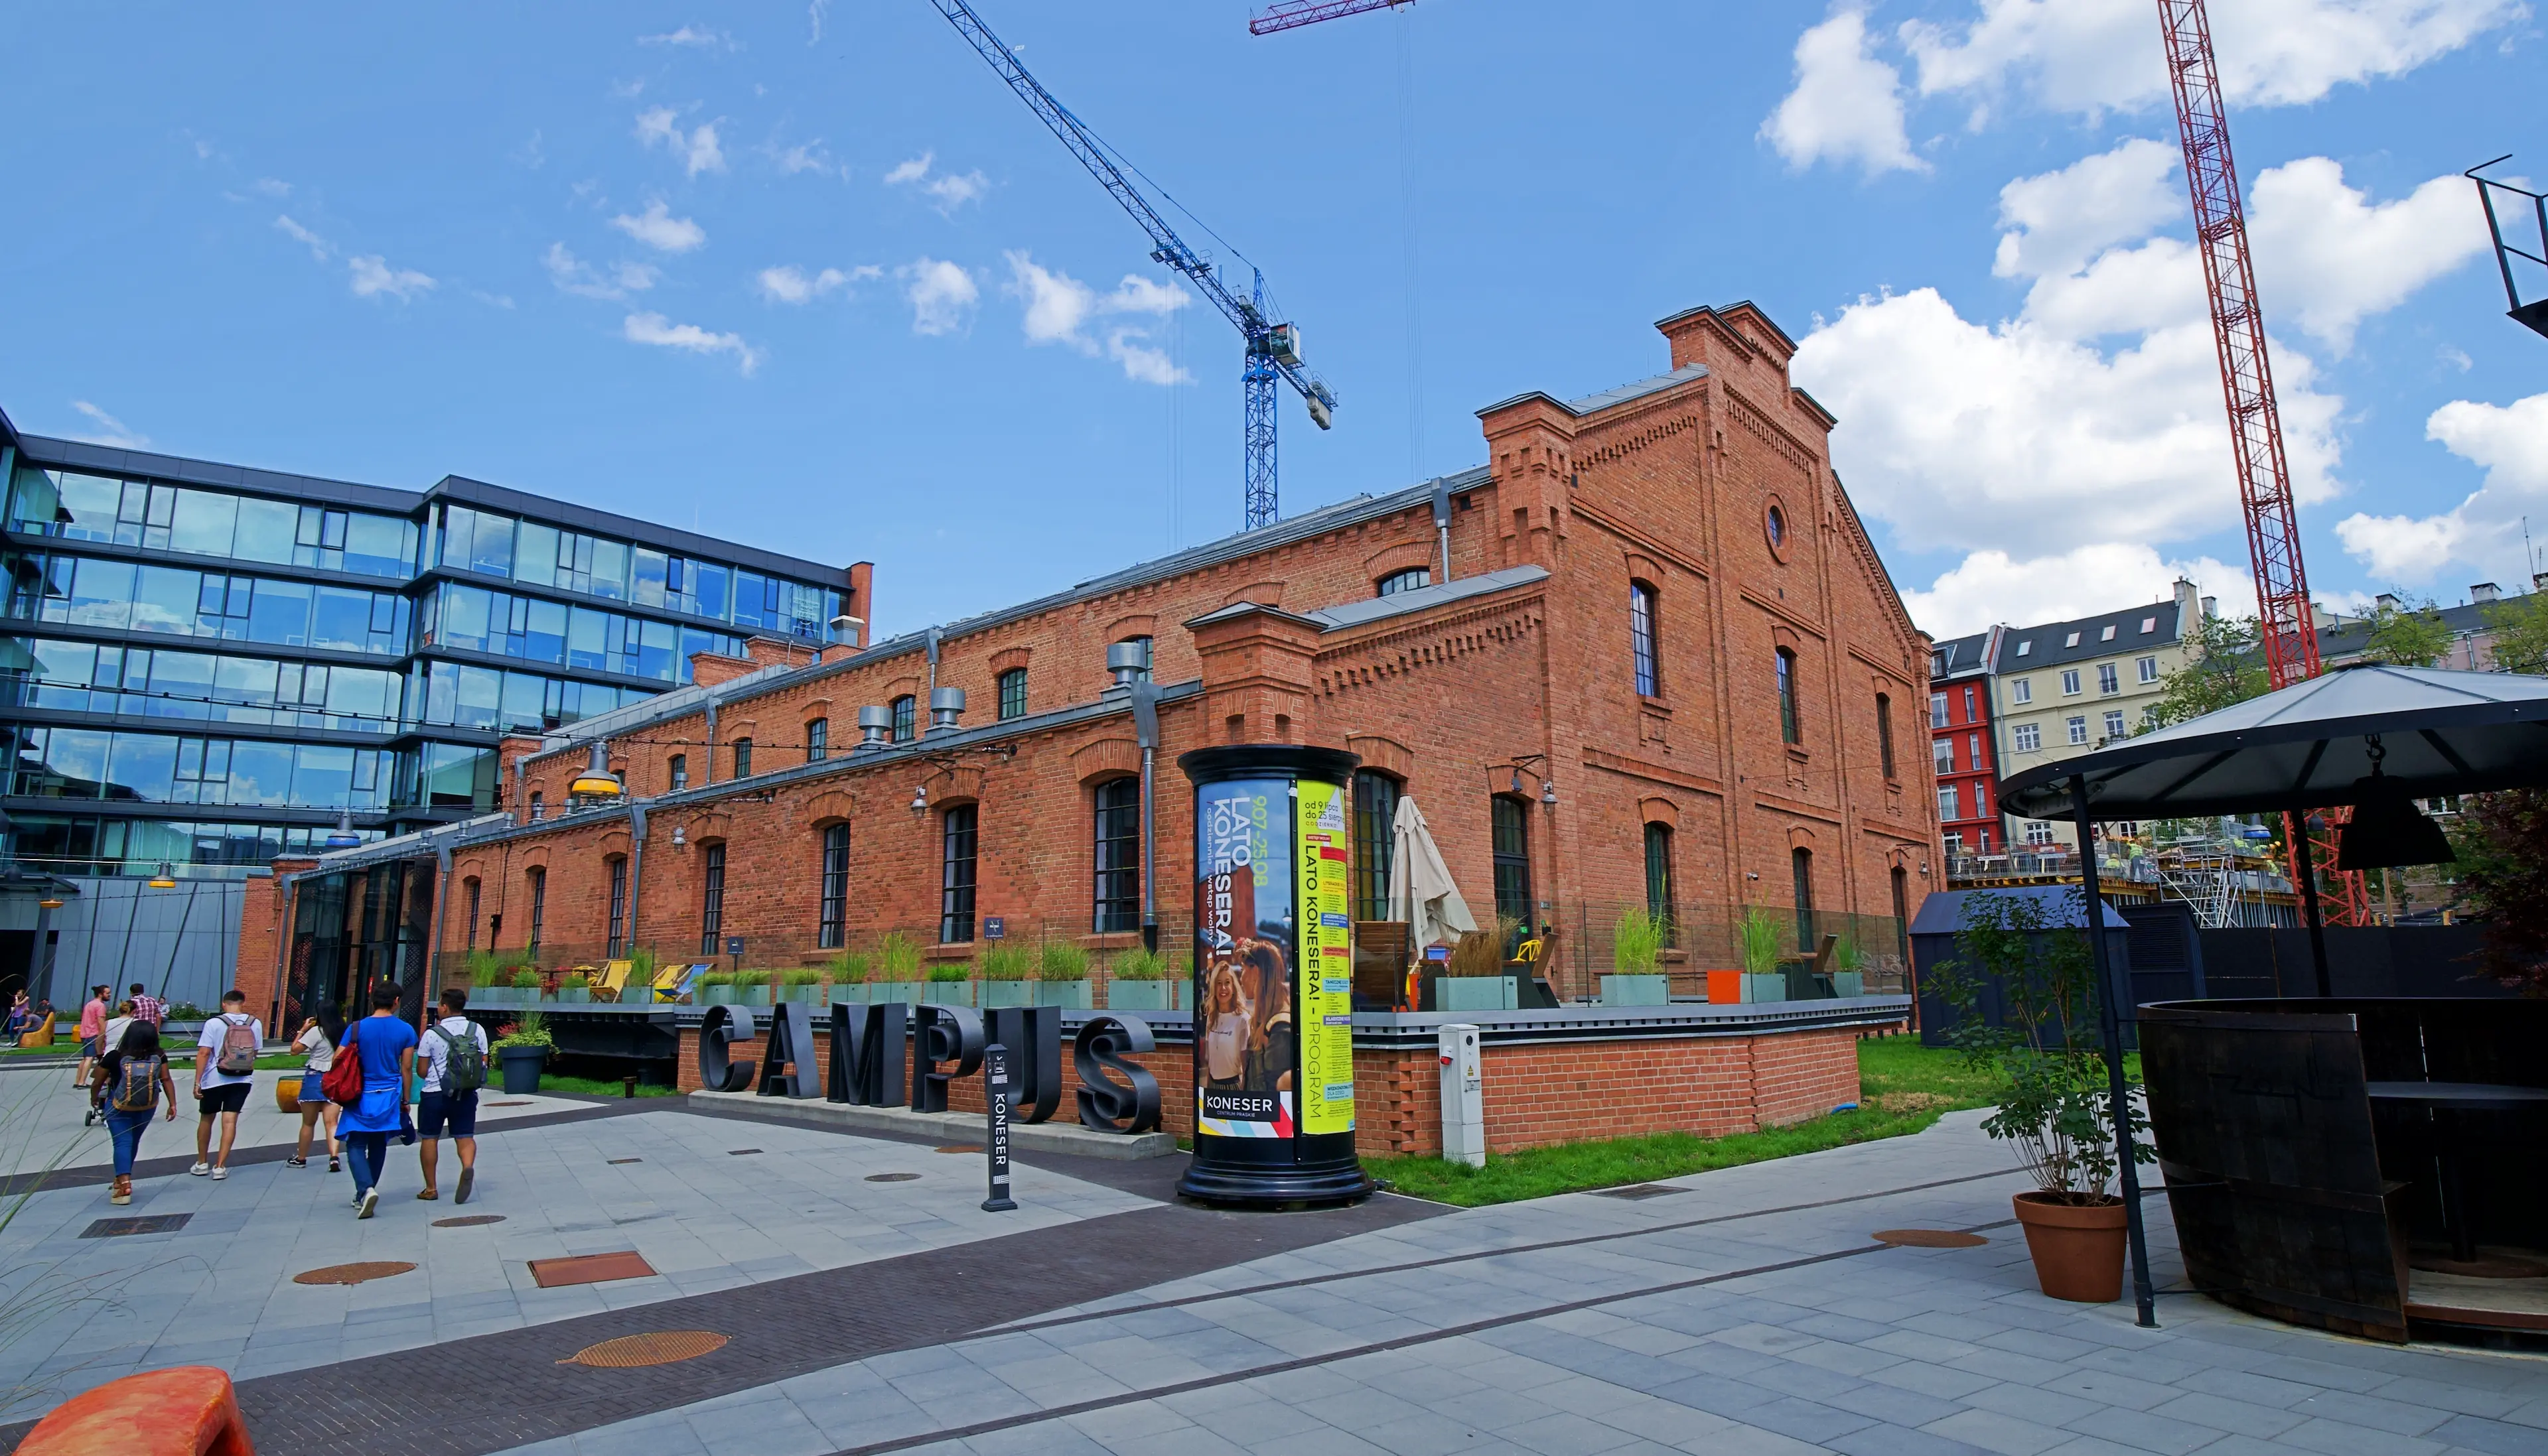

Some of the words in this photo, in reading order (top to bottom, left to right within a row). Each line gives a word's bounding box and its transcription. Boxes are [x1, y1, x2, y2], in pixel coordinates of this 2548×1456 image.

[1232, 797, 1251, 866] LATO
[1305, 810, 1316, 819] do
[1318, 811, 1327, 820] 25
[1318, 801, 1323, 809] 9
[1324, 801, 1338, 813] lipca
[1214, 799, 1232, 955] KONESERA!
[1306, 845, 1317, 890] LATO
[1307, 897, 1320, 1000] KONESERA!
[699, 1001, 1161, 1134] CAMPUS
[1308, 1022, 1322, 1118] PROGRAM
[995, 1093, 1006, 1165] KONESER
[1206, 1095, 1273, 1112] KONESER
